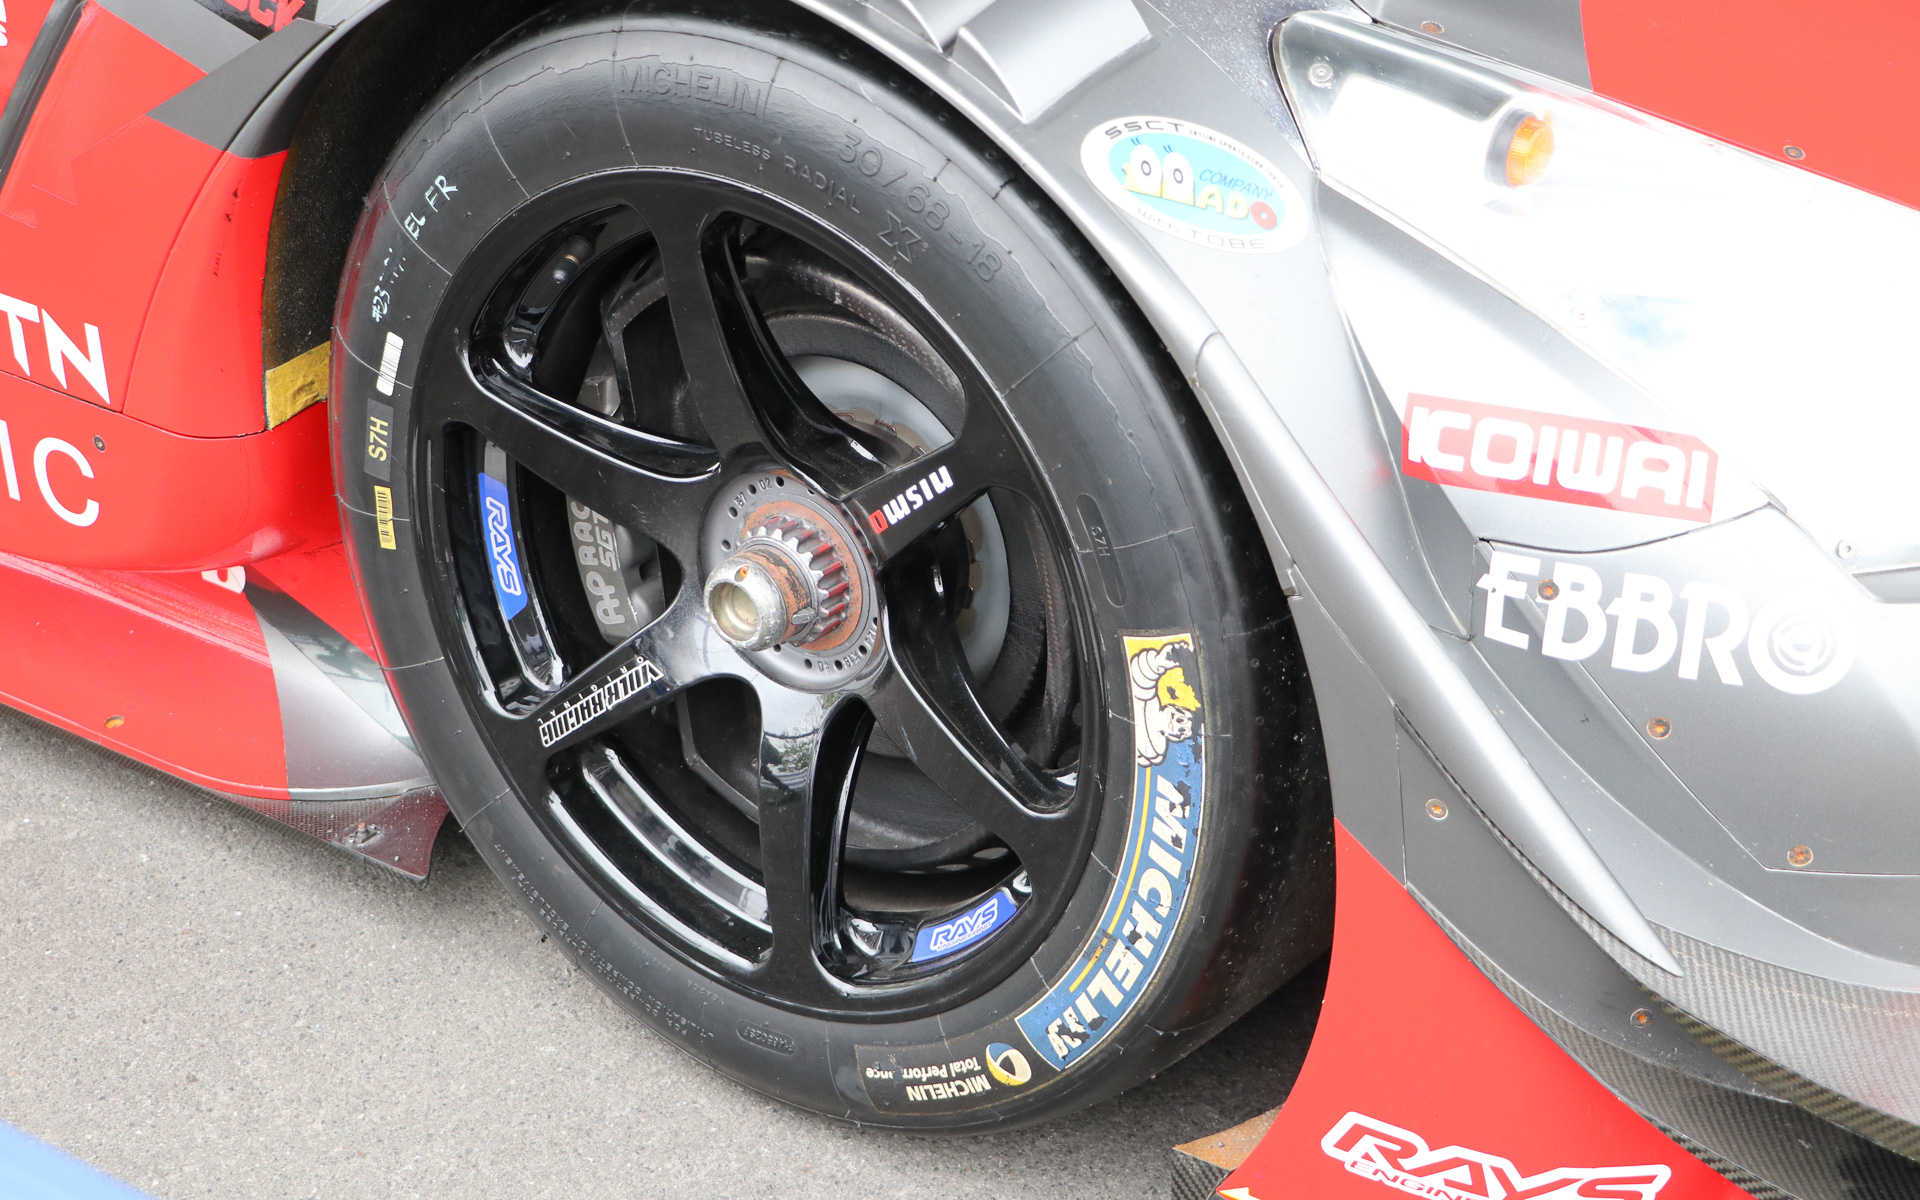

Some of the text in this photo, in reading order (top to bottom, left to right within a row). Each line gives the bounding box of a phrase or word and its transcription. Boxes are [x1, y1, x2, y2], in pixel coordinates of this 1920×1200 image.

[618, 63, 762, 116] MICHELIN
[1104, 120, 1184, 140] SSCT
[694, 127, 861, 214] TUBELESS RADIAL
[1199, 169, 1275, 202] COMPANY
[424, 175, 459, 213] FR
[1189, 229, 1267, 250] TOBE
[368, 416, 389, 462] S7H
[1407, 405, 1709, 510] KOIWAI
[485, 496, 522, 596] RAYS
[1090, 526, 1111, 557] S7H
[1475, 550, 1856, 695] EBBRO
[930, 898, 998, 951] RAYS
[1046, 774, 1191, 1060] MICHELIN
[905, 1073, 992, 1102] MICHELIN
[949, 1056, 982, 1078] Total
